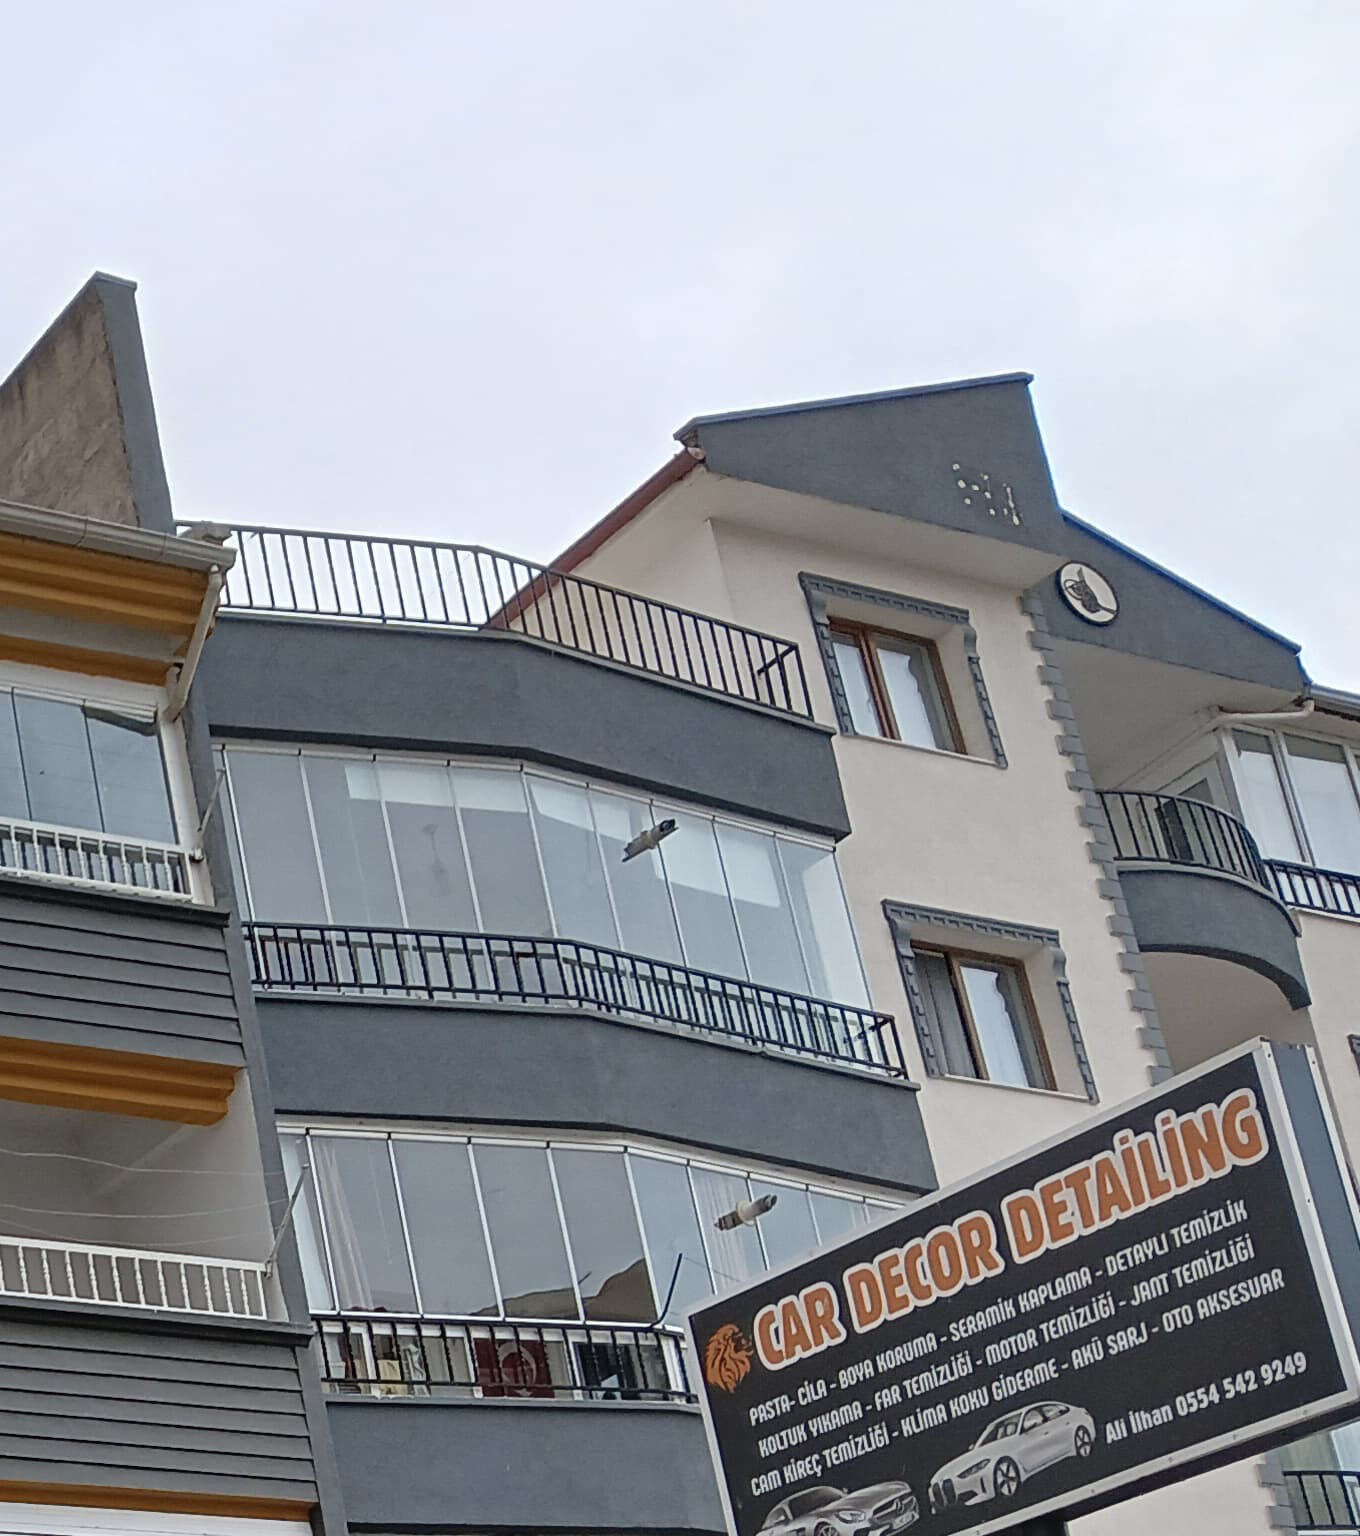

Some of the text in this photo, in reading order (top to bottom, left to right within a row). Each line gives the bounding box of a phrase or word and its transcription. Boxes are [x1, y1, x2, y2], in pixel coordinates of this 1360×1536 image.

[754, 1088, 1269, 1371] CAR DECOR DETAİLİNG
[798, 1378, 827, 1409] CİLA
[838, 1360, 875, 1392] BOYA
[877, 1333, 938, 1379] KORUMA
[949, 1298, 1017, 1345] SERAMİK
[1017, 1266, 1093, 1318] KAPLAMA
[1105, 1236, 1170, 1281] DETAYLI
[1171, 1200, 1248, 1254] TEMİZLİK
[750, 1471, 782, 1499] CAM
[783, 1452, 824, 1489] KİREÇ
[823, 1424, 890, 1468] TEMİZLİĞİ
[901, 1402, 947, 1442] KLİMA
[948, 1385, 992, 1421] KOKU
[992, 1357, 1060, 1408] GİDERME
[1072, 1337, 1105, 1372] AKÜ
[1162, 1307, 1193, 1336] OTO
[1195, 1268, 1285, 1325] AKSESUAR
[758, 1234, 1256, 1458] KOLTUK YIKAMA FAR TEMİZLİĞİ MOTOR TEMİZLİĞİ JANT TEMİZLİĞİ
[1105, 1351, 1308, 1445] Ali İlhan 0554 542 9249
